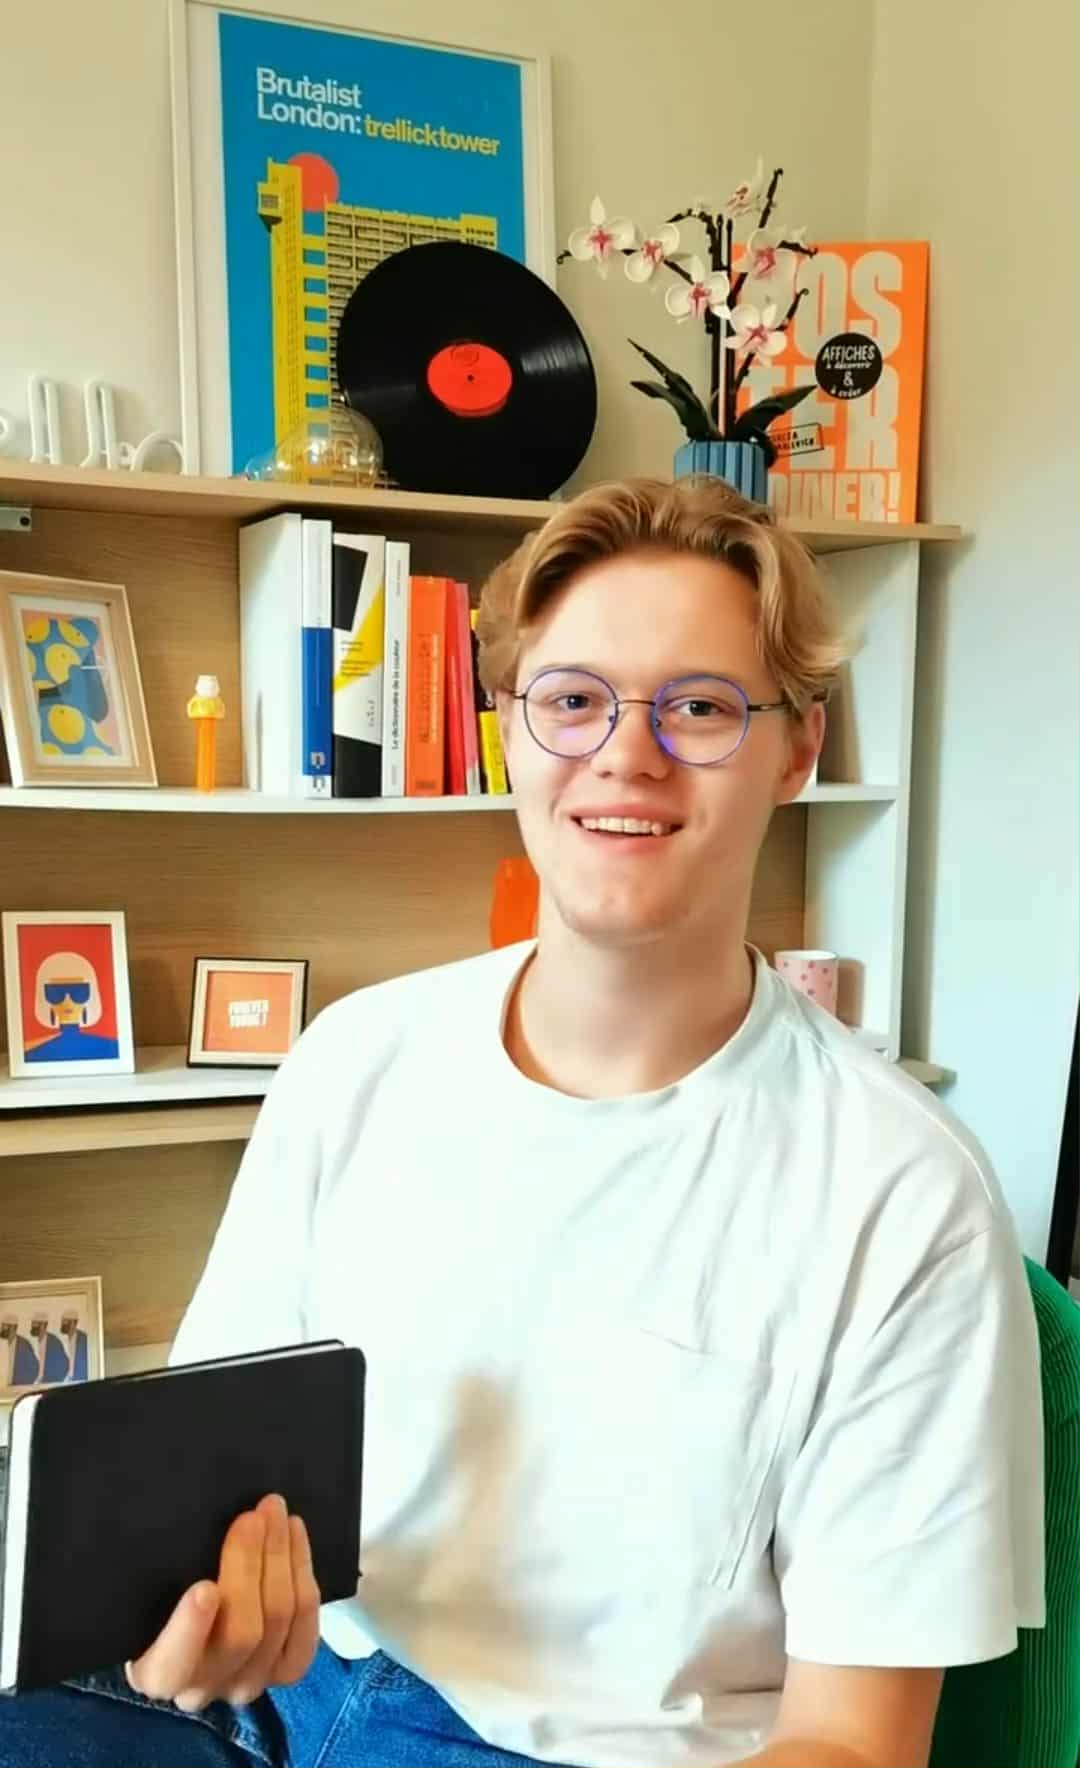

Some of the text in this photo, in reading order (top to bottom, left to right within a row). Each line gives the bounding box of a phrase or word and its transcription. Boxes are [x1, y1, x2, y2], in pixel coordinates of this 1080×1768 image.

[256, 67, 362, 109] Brutalist
[257, 93, 362, 135] London:
[822, 345, 875, 363] AFFICHES
[843, 371, 854, 386] &
